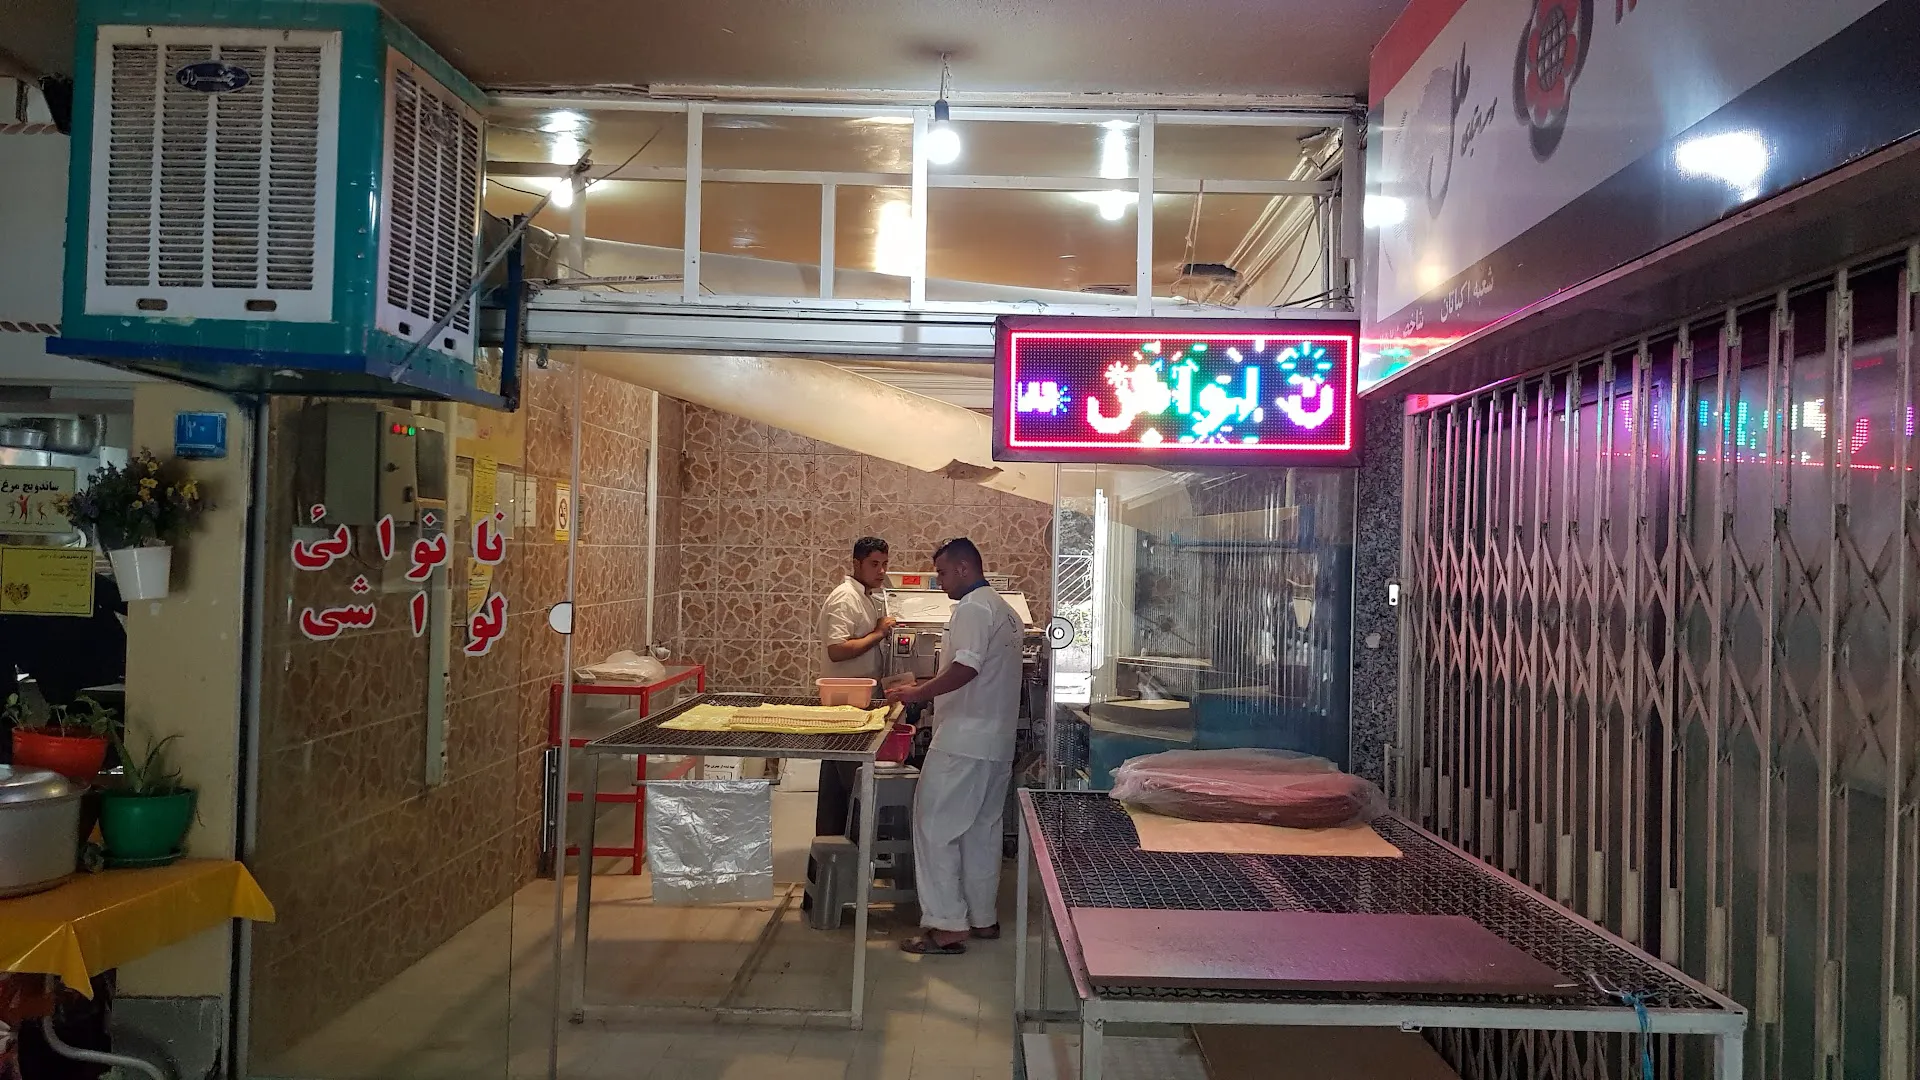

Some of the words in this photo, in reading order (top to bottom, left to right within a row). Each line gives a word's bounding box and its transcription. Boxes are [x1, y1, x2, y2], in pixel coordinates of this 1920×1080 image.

[1440, 280, 1471, 323] اکباتان
[1472, 266, 1494, 306] شعبه
[1, 479, 20, 493] مرغ
